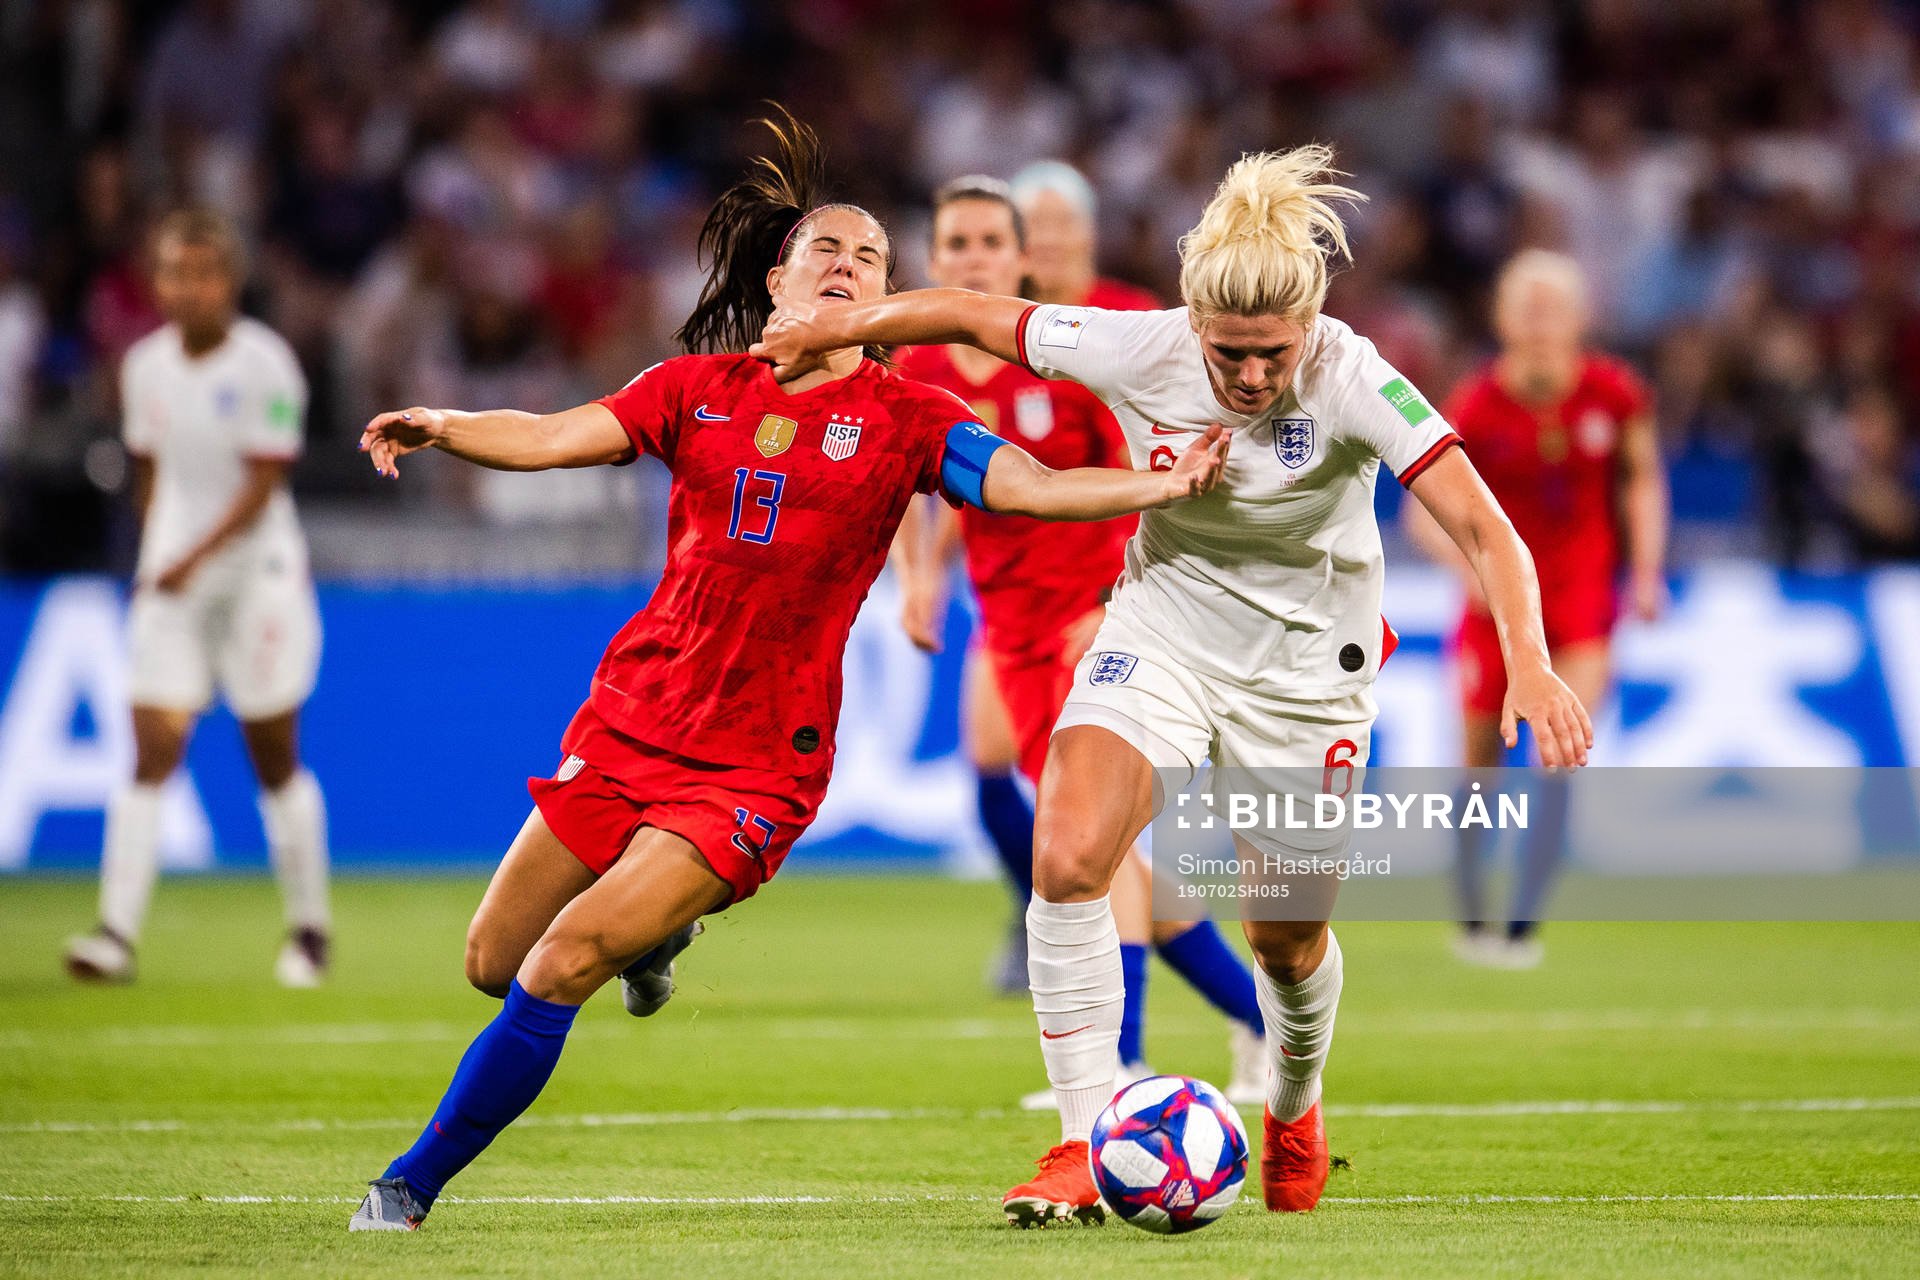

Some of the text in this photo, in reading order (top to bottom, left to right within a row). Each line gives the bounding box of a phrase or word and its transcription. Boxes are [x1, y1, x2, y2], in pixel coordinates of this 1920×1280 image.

[763, 439, 780, 448] FIFA
[829, 425, 859, 440] USA
[727, 467, 786, 545] 13
[1322, 739, 1358, 815] 6
